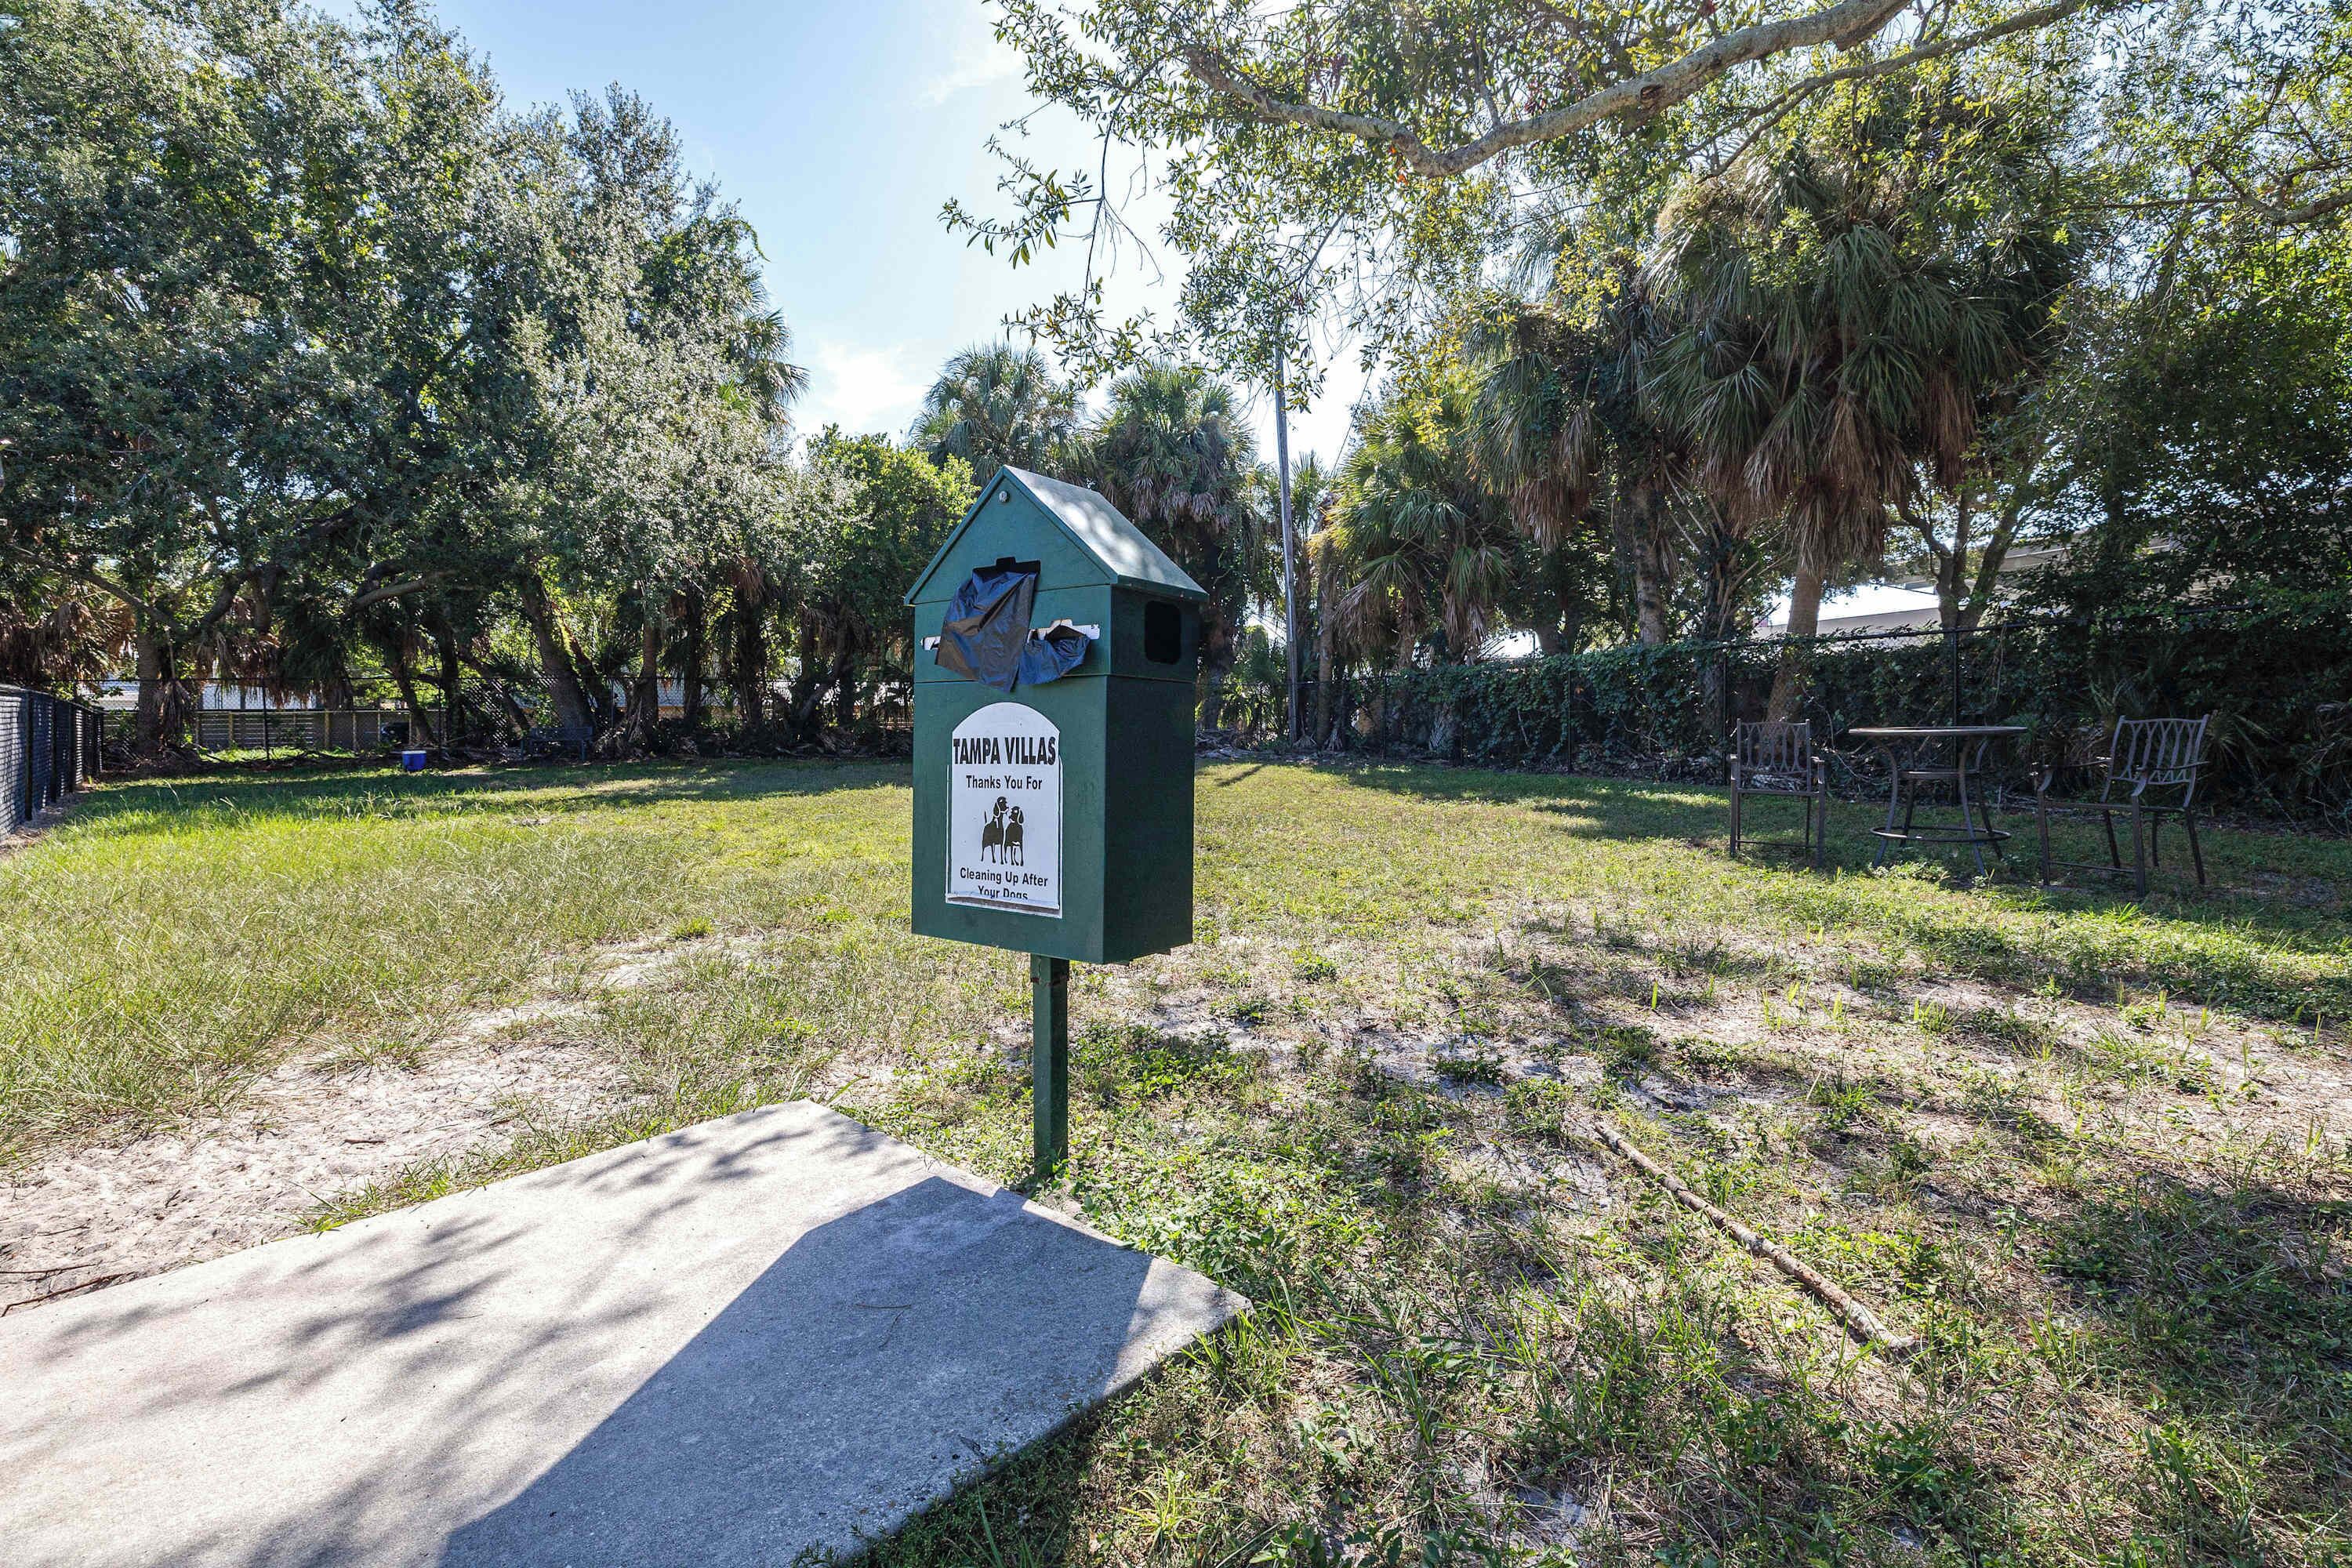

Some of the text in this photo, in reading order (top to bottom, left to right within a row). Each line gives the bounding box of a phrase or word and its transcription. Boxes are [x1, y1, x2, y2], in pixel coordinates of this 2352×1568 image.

[953, 736, 1056, 765] TAMPA VILLAS
[966, 775, 1043, 790] Thanks You For
[960, 868, 1048, 887] Cleaning Up After
